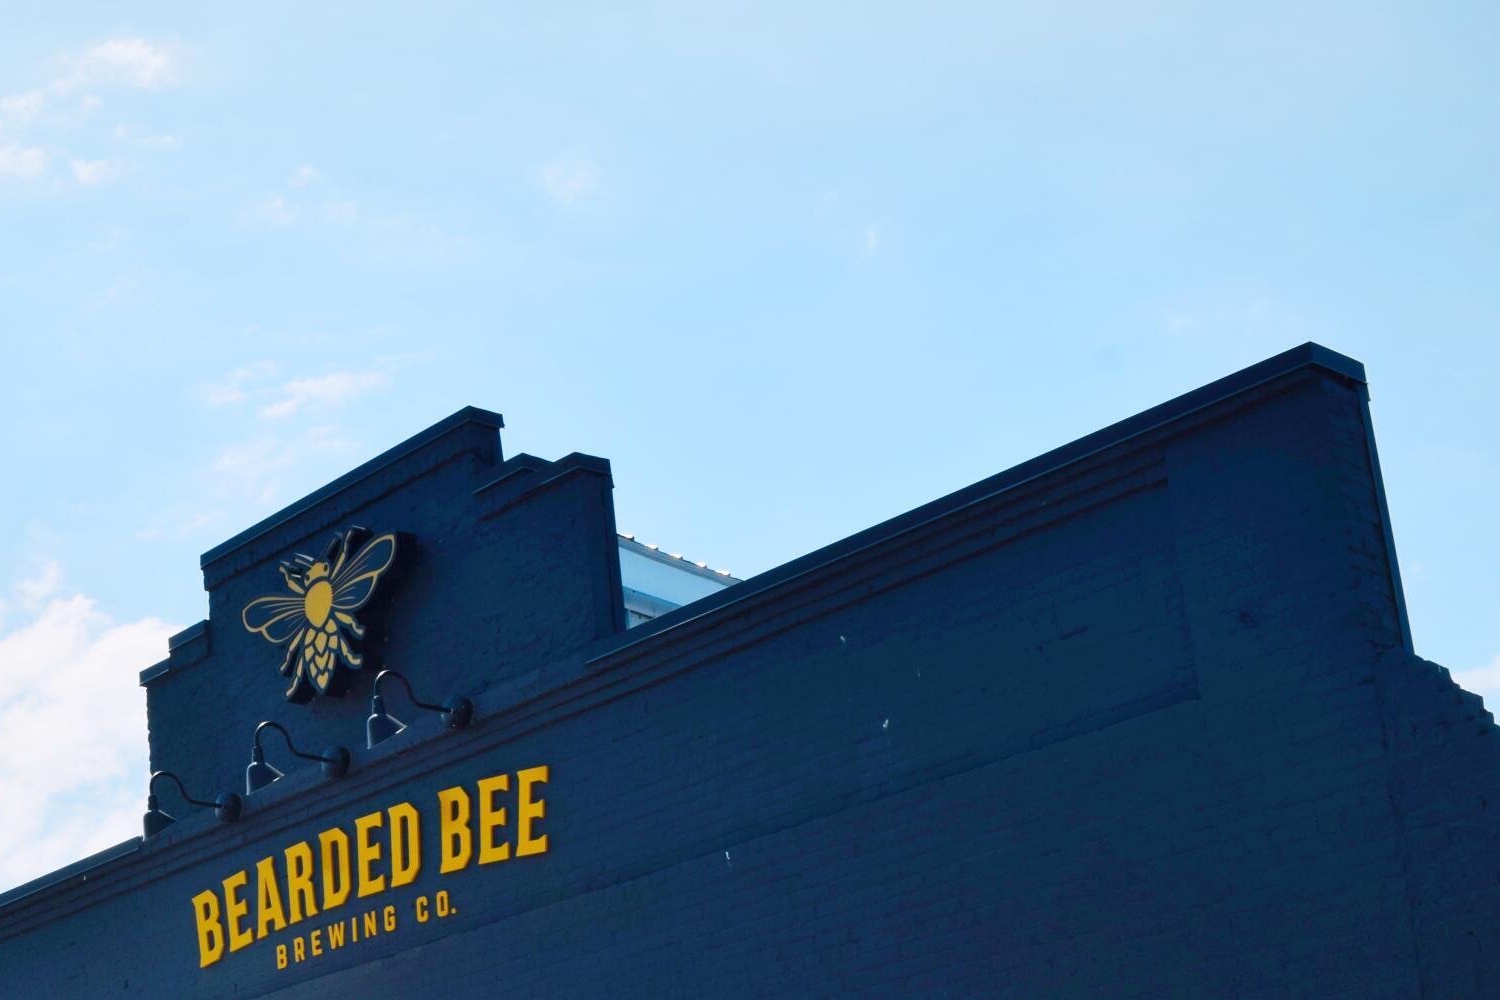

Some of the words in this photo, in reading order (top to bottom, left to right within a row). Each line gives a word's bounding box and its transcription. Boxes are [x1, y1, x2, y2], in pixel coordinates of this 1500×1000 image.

[191, 801, 422, 969] BEARDED
[437, 764, 550, 874] BEE
[276, 904, 396, 970] BREWING
[416, 890, 457, 923] CO.
